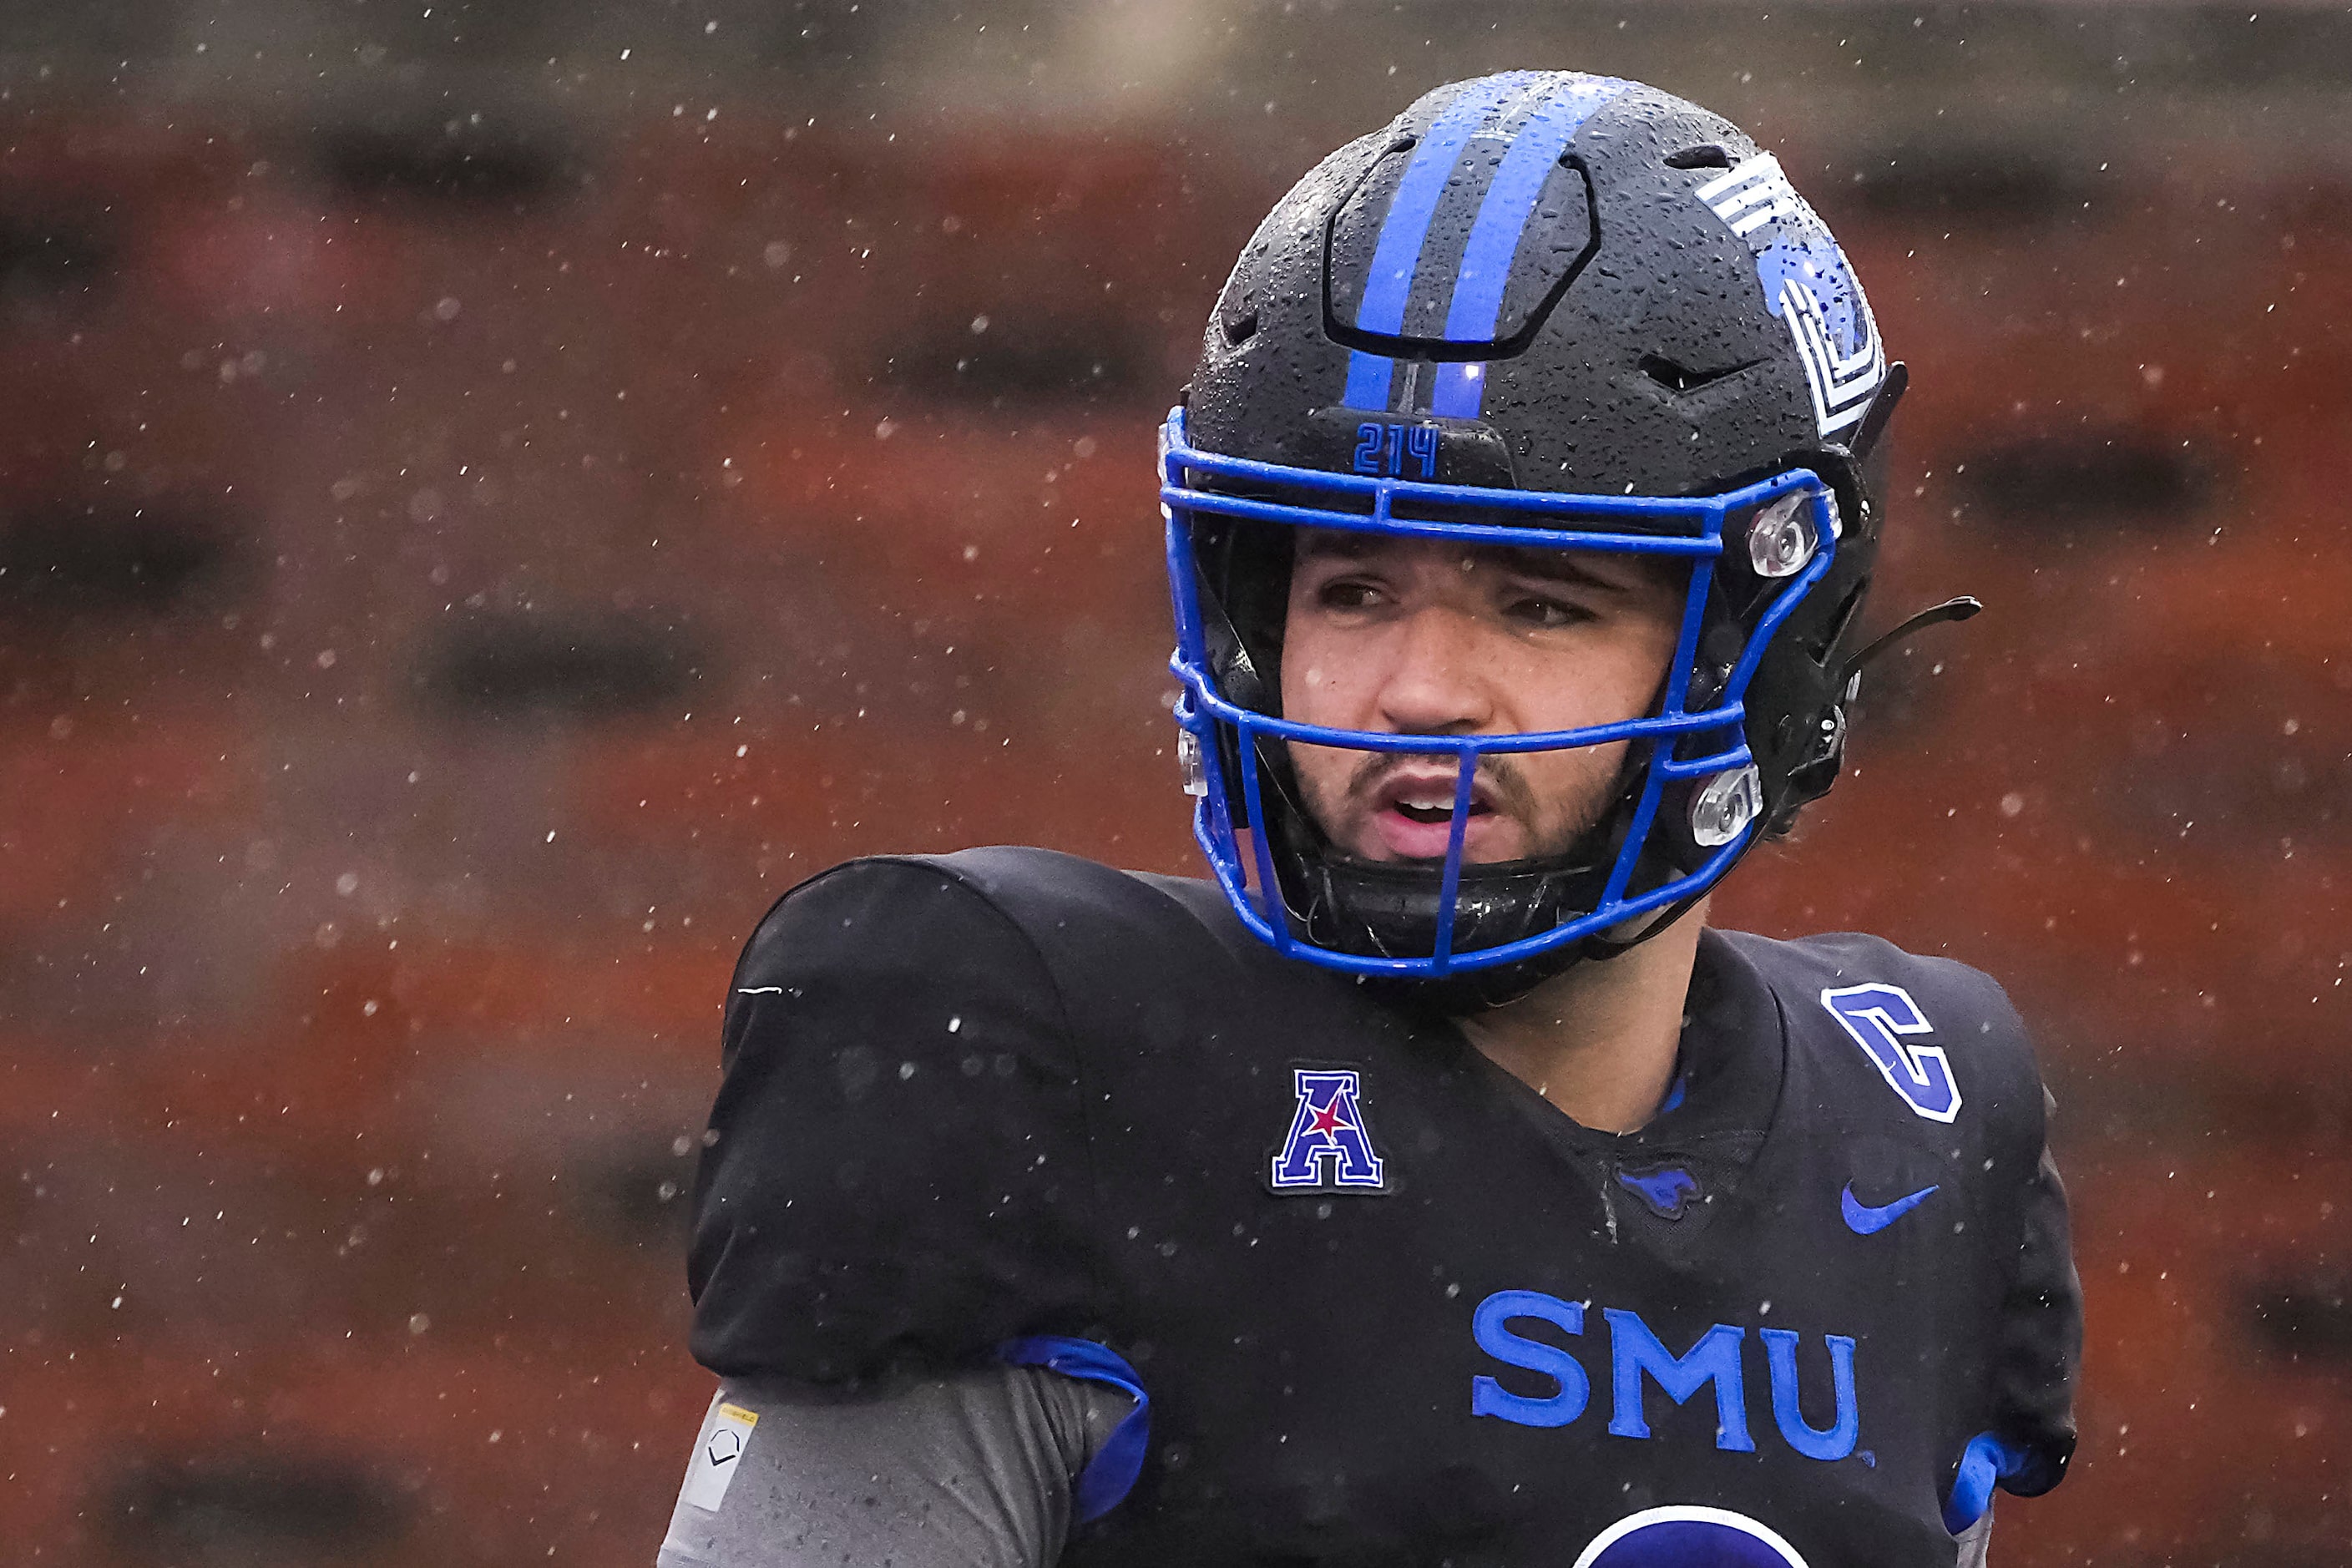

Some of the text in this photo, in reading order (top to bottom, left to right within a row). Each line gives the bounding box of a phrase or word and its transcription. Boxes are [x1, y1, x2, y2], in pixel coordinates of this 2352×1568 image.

[1353, 422, 1439, 478] 214
[1820, 982, 1963, 1124] C
[1272, 1070, 1383, 1187] A
[1472, 1289, 1859, 1461] SMU
